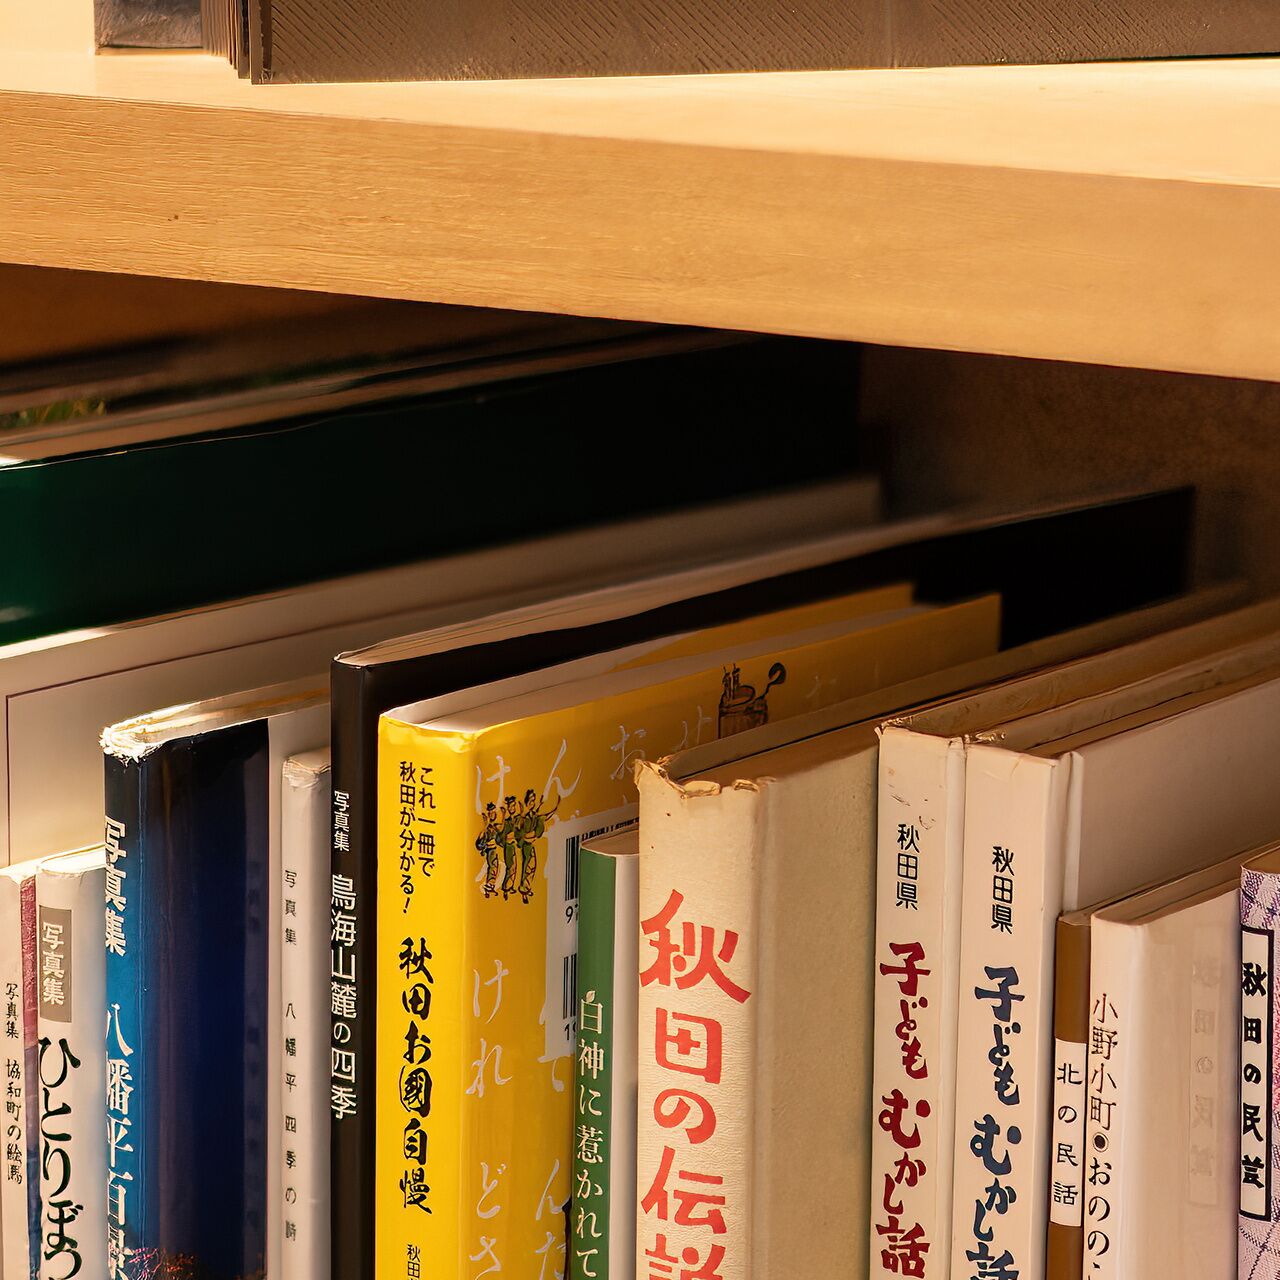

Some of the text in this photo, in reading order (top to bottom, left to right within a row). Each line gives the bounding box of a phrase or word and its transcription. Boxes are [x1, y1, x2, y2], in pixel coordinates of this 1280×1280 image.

[105, 815, 127, 956] 写真集
[399, 760, 418, 914] 秋田が分かる!
[417, 766, 436, 878] これ一冊で
[895, 824, 920, 911] 秋田県
[990, 846, 1014, 934] 秋田県
[42, 922, 65, 1007] 写真集
[284, 871, 297, 946] 写真集
[329, 790, 358, 1119] 写真集 鳥海山麓の四季
[5, 982, 19, 1039] 写真集
[399, 937, 434, 1214] 秋田お國自慢
[880, 941, 931, 1081] 子ども
[974, 966, 1025, 1106] 子ども
[1089, 992, 1119, 1131] 小野小町
[1241, 961, 1267, 1190] 秋田の民芸
[576, 991, 606, 1280] 白神に惹かれて
[875, 1087, 931, 1280] むかし話
[1051, 1061, 1083, 1208] 北の民話
